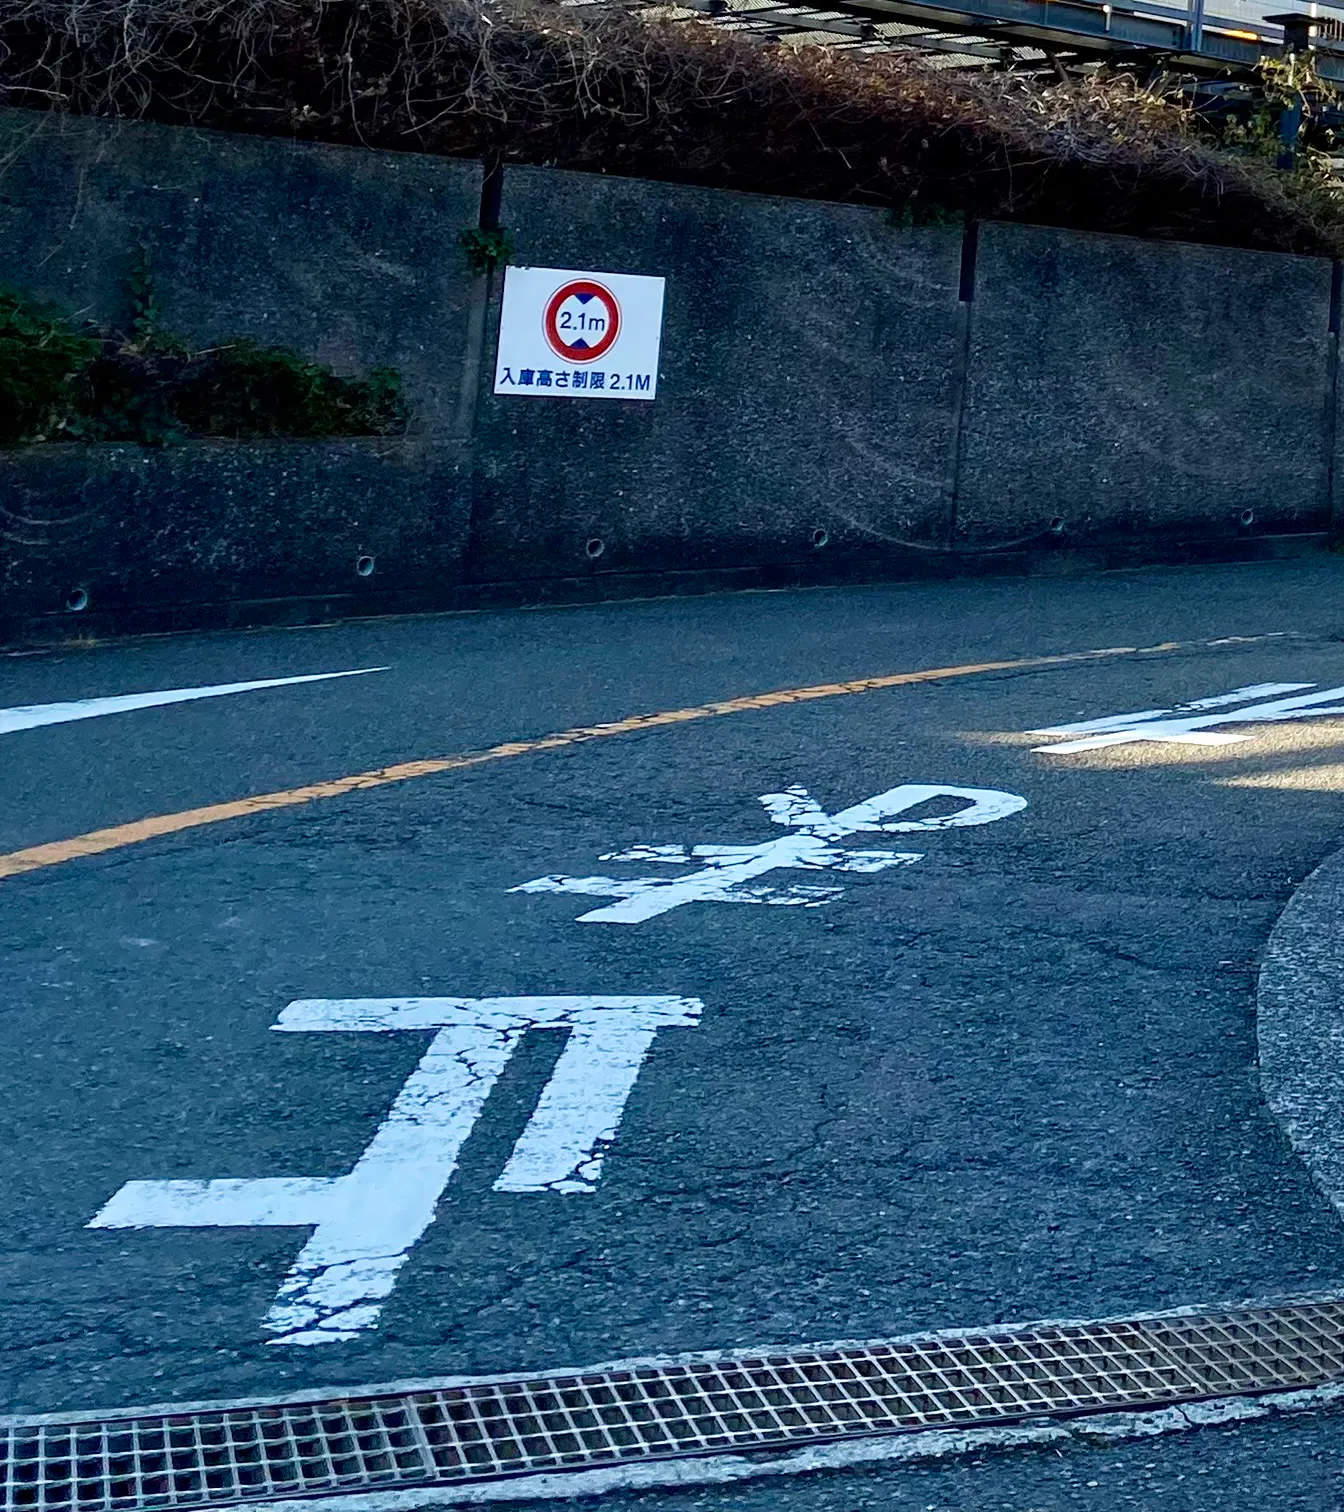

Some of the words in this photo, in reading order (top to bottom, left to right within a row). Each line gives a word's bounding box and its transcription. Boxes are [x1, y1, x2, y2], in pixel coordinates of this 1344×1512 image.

[560, 311, 606, 332] 2.1m
[499, 367, 606, 390] 入庫高さ制限
[610, 374, 651, 392] 2.1M
